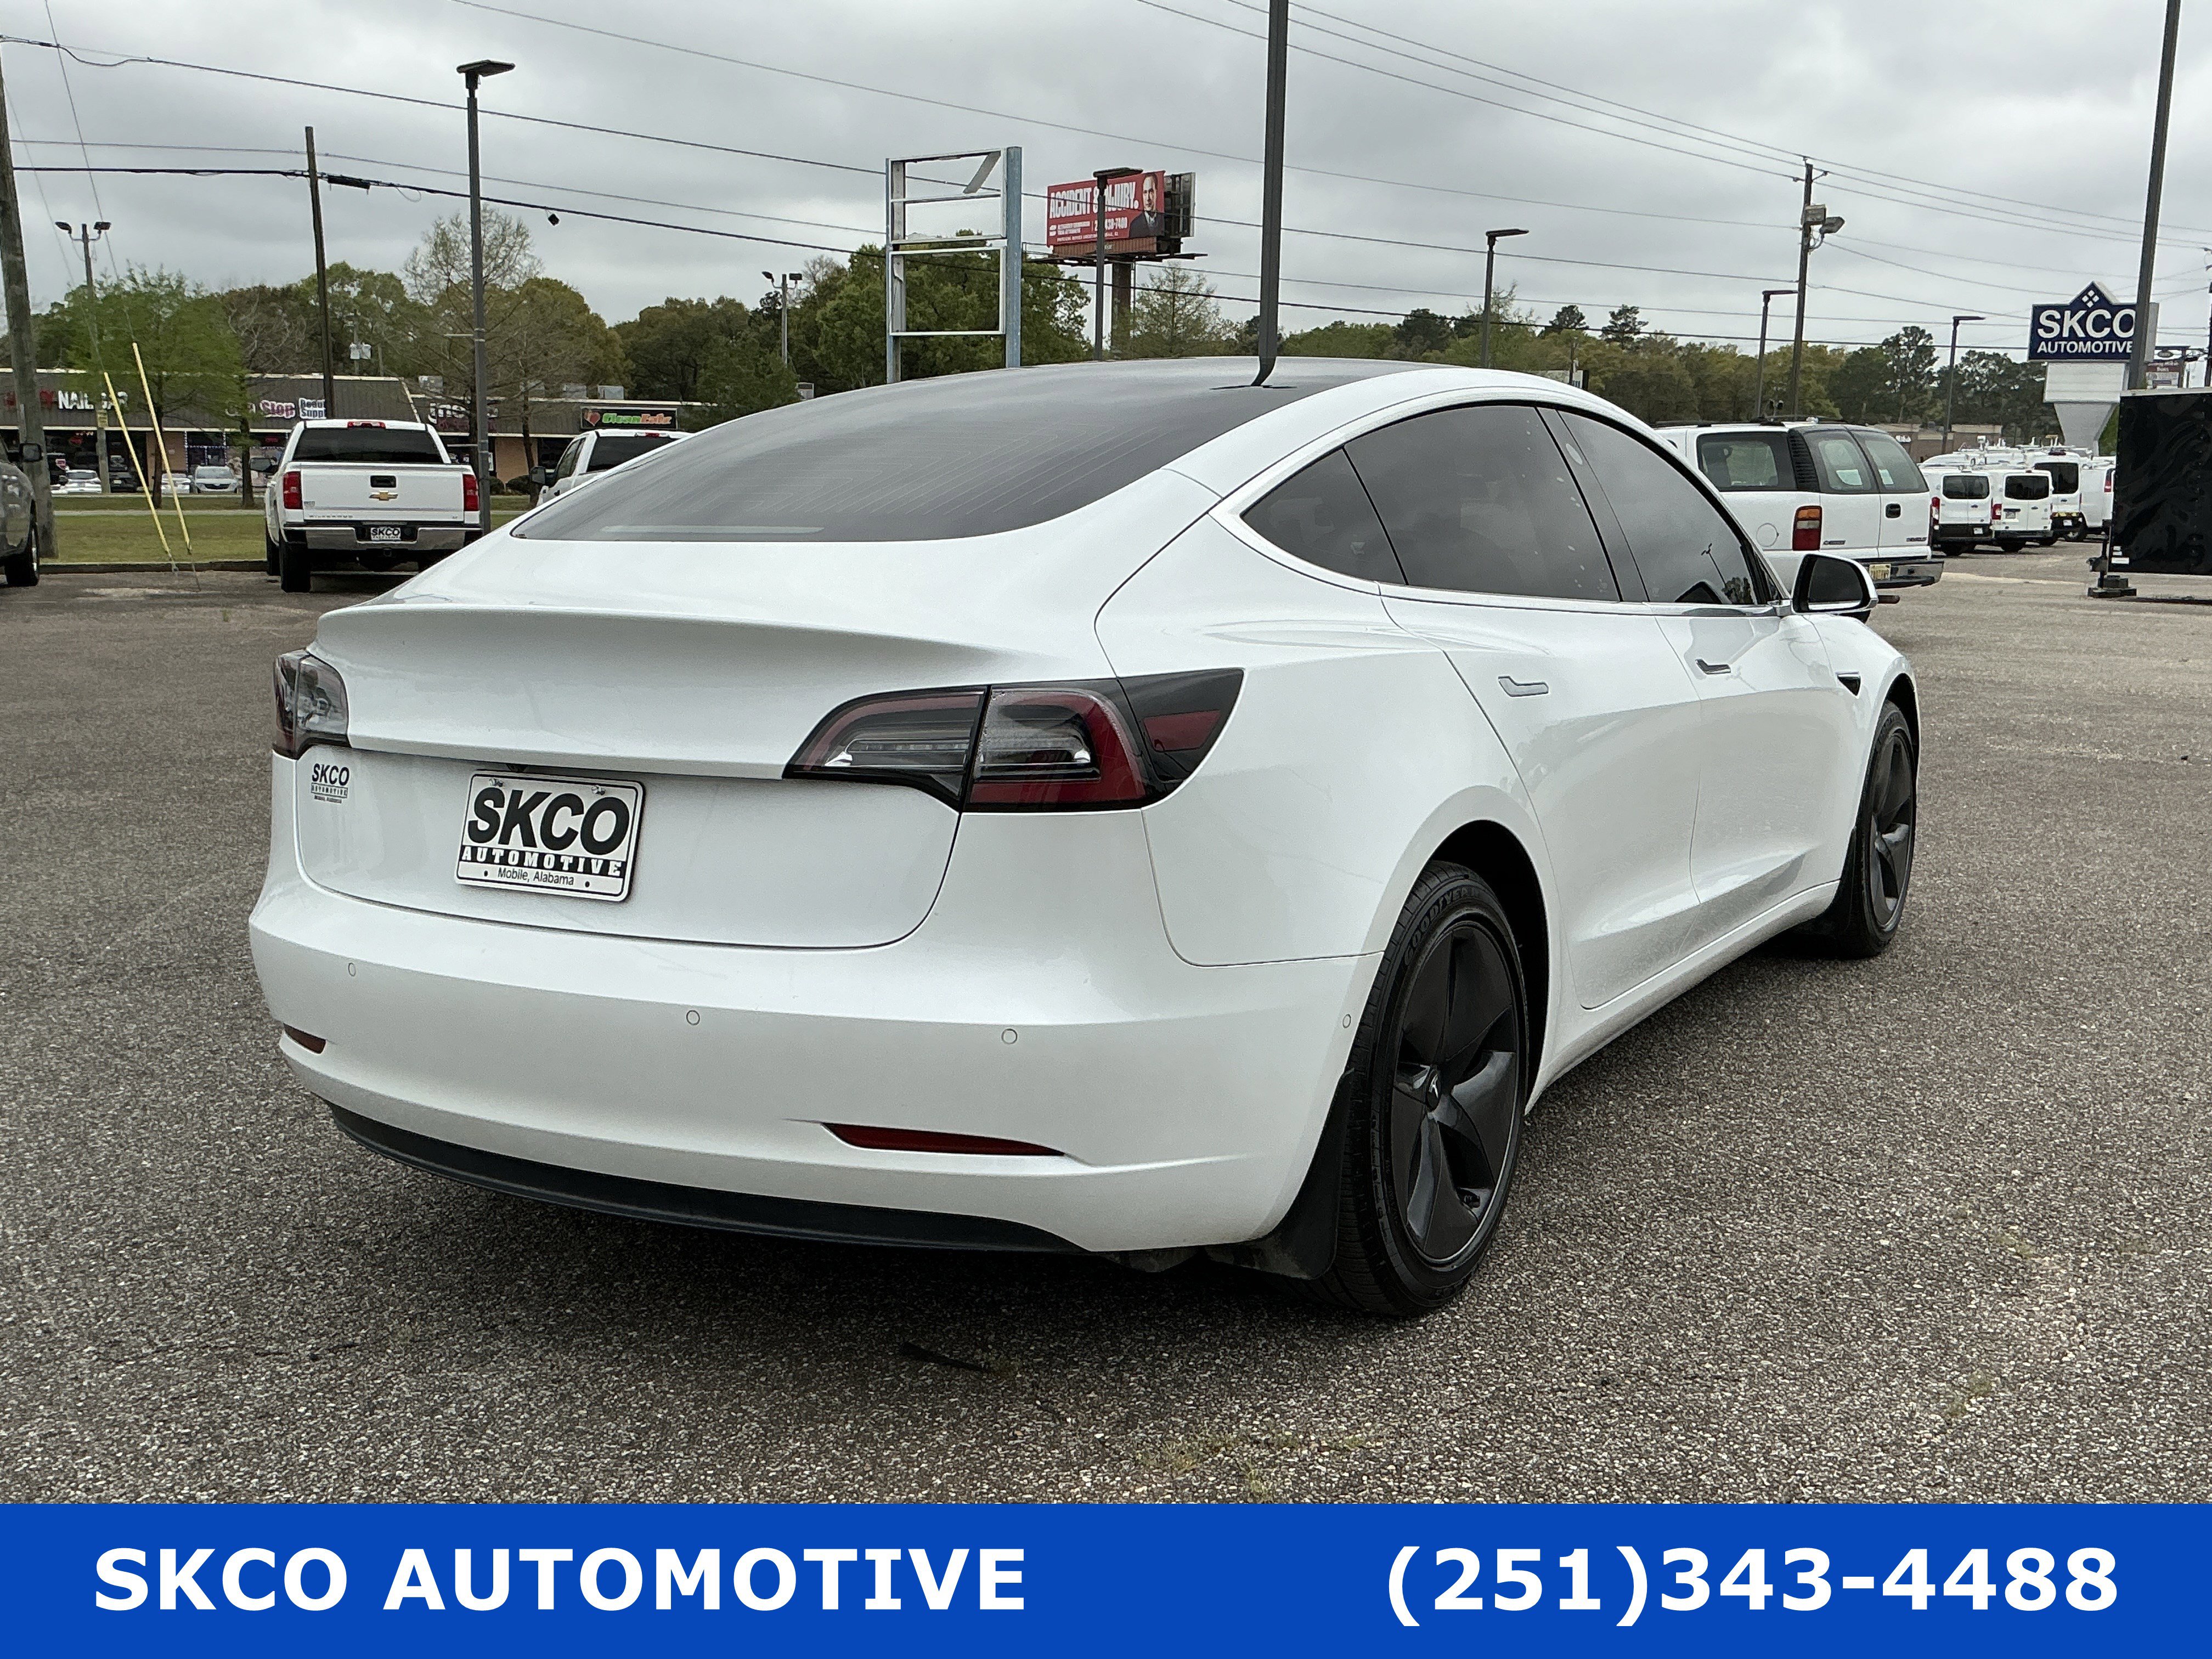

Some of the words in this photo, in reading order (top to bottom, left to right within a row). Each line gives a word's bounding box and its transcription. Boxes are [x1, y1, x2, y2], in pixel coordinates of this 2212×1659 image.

[1049, 187, 1092, 219] ACCIDENT
[1104, 182, 1139, 212] NJURY.
[2037, 309, 2136, 338] SKCO
[2037, 340, 2133, 354] AUTOMOTIVE
[58, 390, 94, 409] NAIL
[301, 399, 325, 408] Beaut
[301, 409, 326, 419] Supp
[312, 763, 349, 786] SKCO
[468, 787, 630, 855] SKCO
[461, 845, 622, 877] AUTOMOTIVE
[498, 867, 530, 883] Mobile,
[533, 874, 574, 886] Alabama
